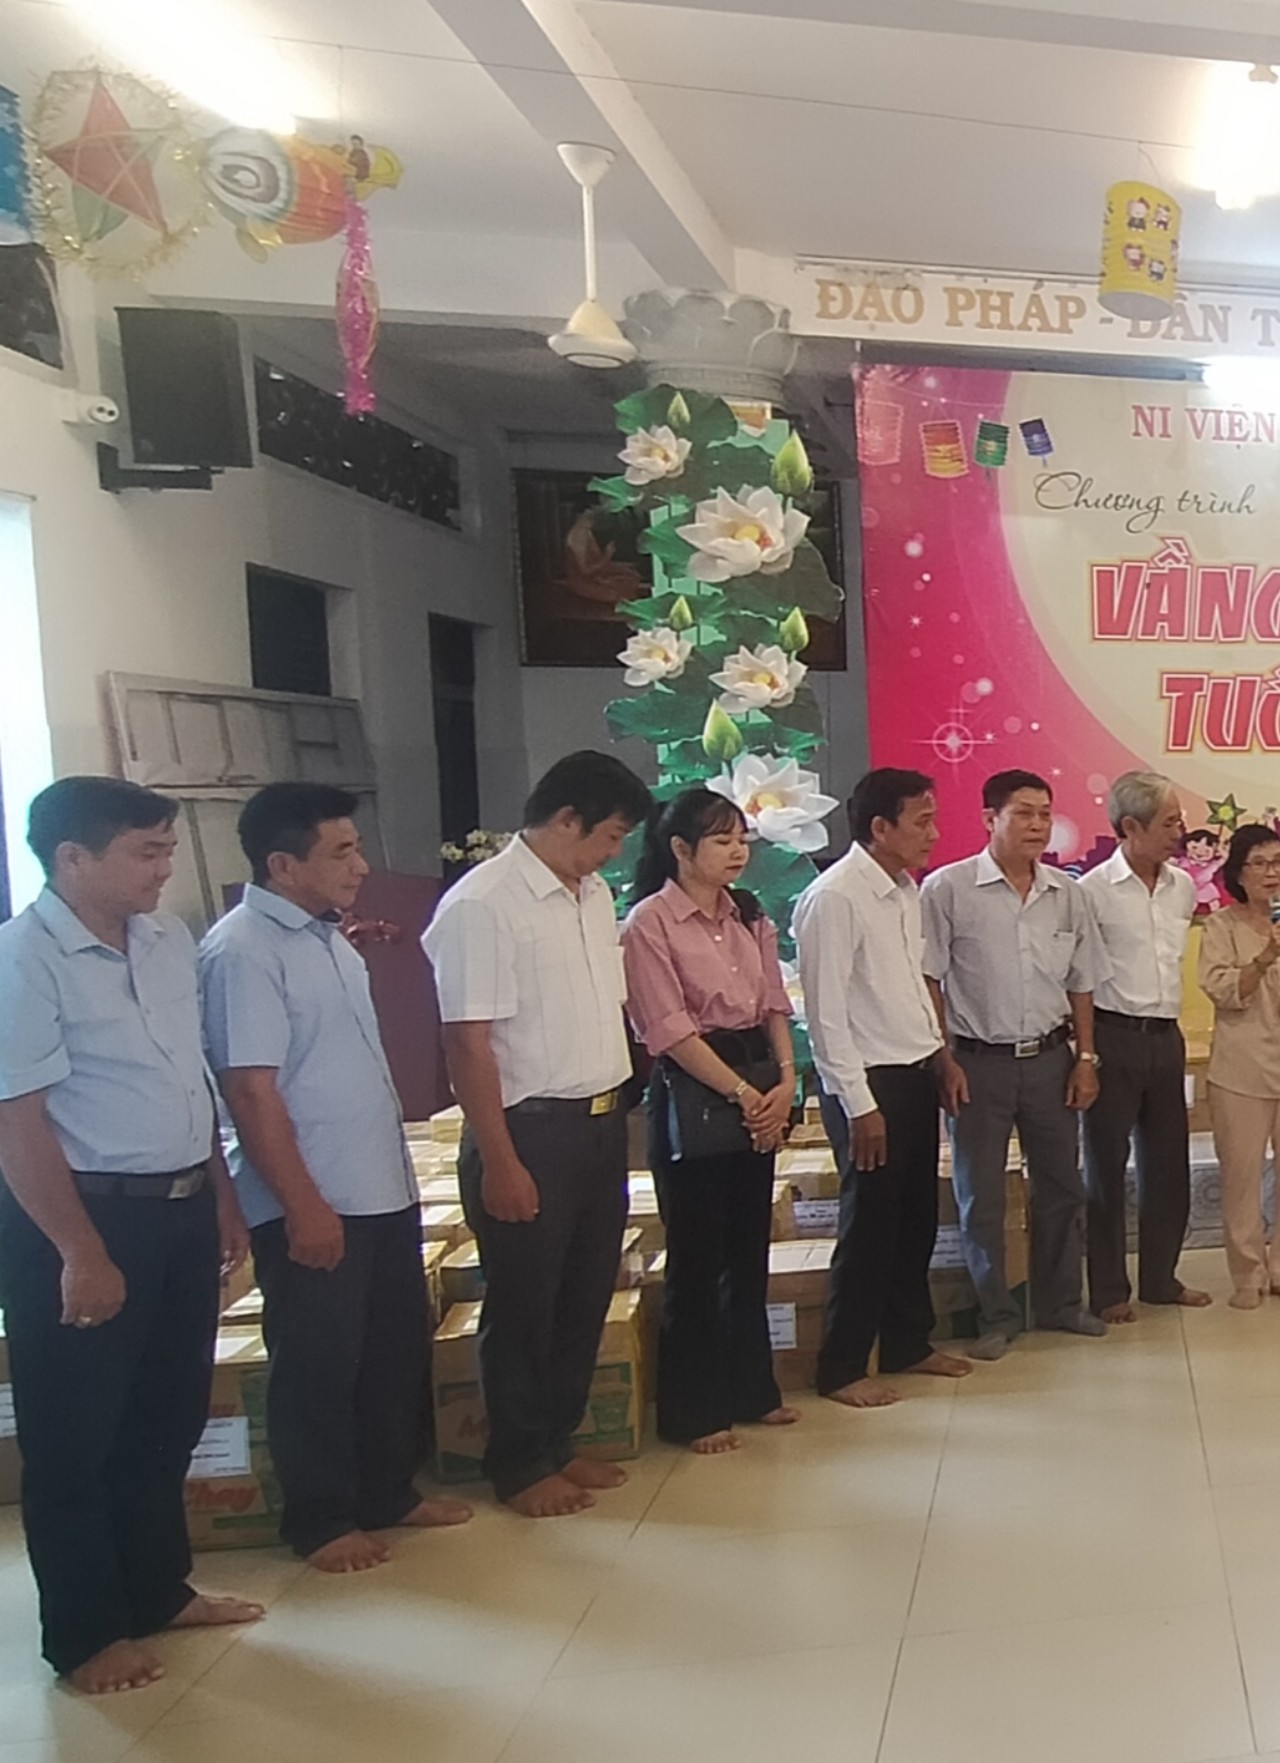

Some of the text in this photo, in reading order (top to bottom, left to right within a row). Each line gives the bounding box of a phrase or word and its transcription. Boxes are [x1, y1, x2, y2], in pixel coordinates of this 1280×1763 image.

[815, 278, 925, 331] ĐẠO
[944, 281, 1087, 334] PHÁP
[1132, 405, 1172, 438] NI
[1184, 403, 1278, 449] VIỆN
[1034, 471, 1256, 534] Chương trình
